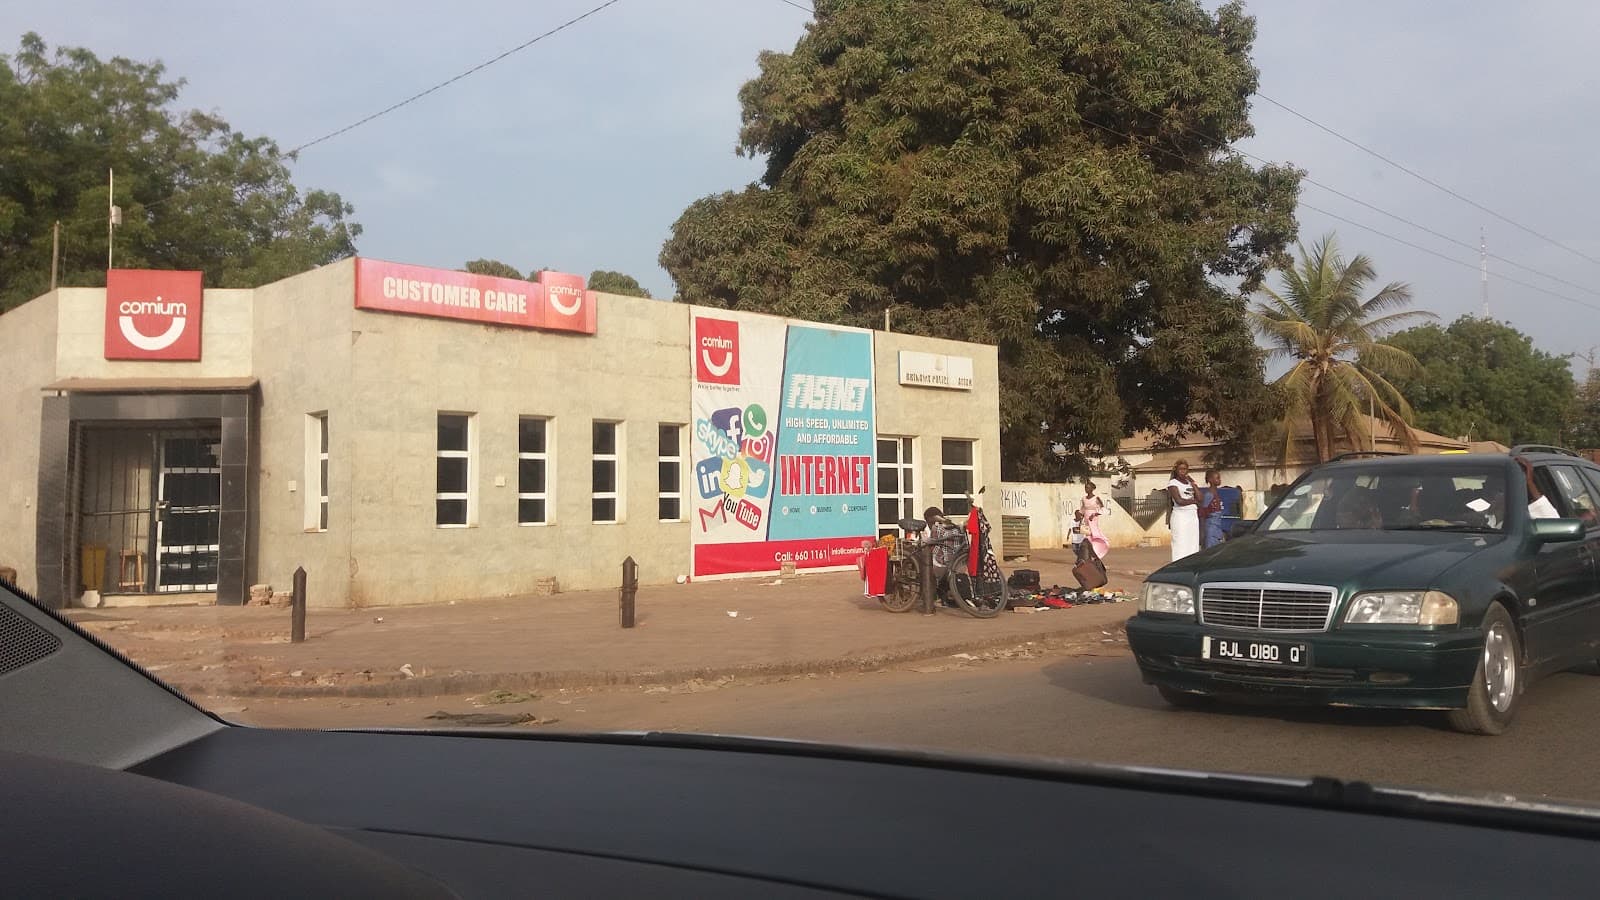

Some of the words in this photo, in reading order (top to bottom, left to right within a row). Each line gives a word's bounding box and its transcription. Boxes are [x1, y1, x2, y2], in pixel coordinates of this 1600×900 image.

[383, 276, 480, 309] CUSTOMER
[484, 290, 527, 314] CARE
[550, 285, 582, 297] comium
[119, 295, 187, 315] comium
[702, 336, 733, 349] comium
[786, 374, 870, 412] FASTNET
[786, 417, 804, 428] HIGH
[806, 418, 831, 430] SPEED,
[832, 419, 869, 430] UNLIMITED
[698, 422, 737, 459] skype
[797, 433, 812, 444] AND
[813, 433, 858, 445] AFFORDABLE
[780, 454, 872, 496] INTERNET
[774, 551, 793, 562] Call:
[795, 550, 809, 561] 660
[810, 549, 827, 559] 1161
[1219, 641, 1243, 658] BJL
[1290, 647, 1300, 662] Q
